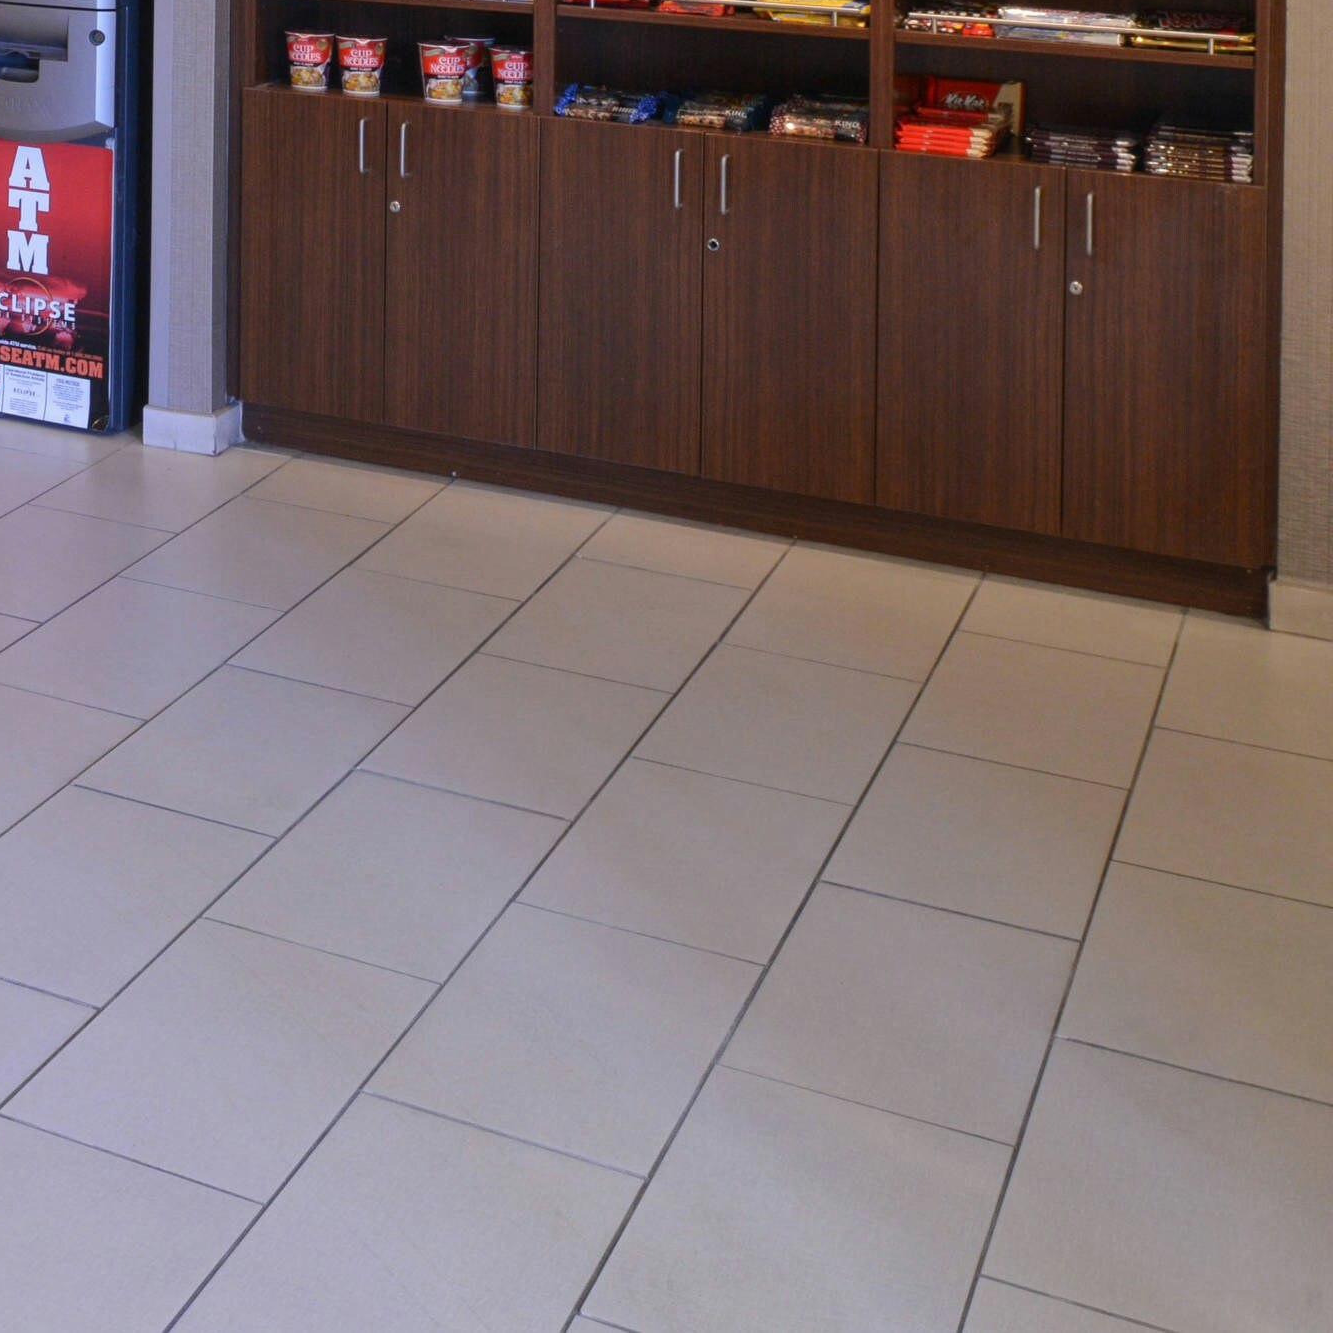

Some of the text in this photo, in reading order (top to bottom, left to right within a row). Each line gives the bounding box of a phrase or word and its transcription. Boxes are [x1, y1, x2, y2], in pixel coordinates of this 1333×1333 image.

[293, 44, 314, 53] CUP
[350, 49, 373, 57] CUP
[290, 51, 322, 61] NOODLES
[343, 56, 379, 65] NOODLES
[438, 56, 461, 65] CUP
[504, 61, 528, 70] CUP
[835, 120, 860, 129] KIND
[6, 145, 50, 275] ATM
[21, 314, 76, 331] SYSTEMS
